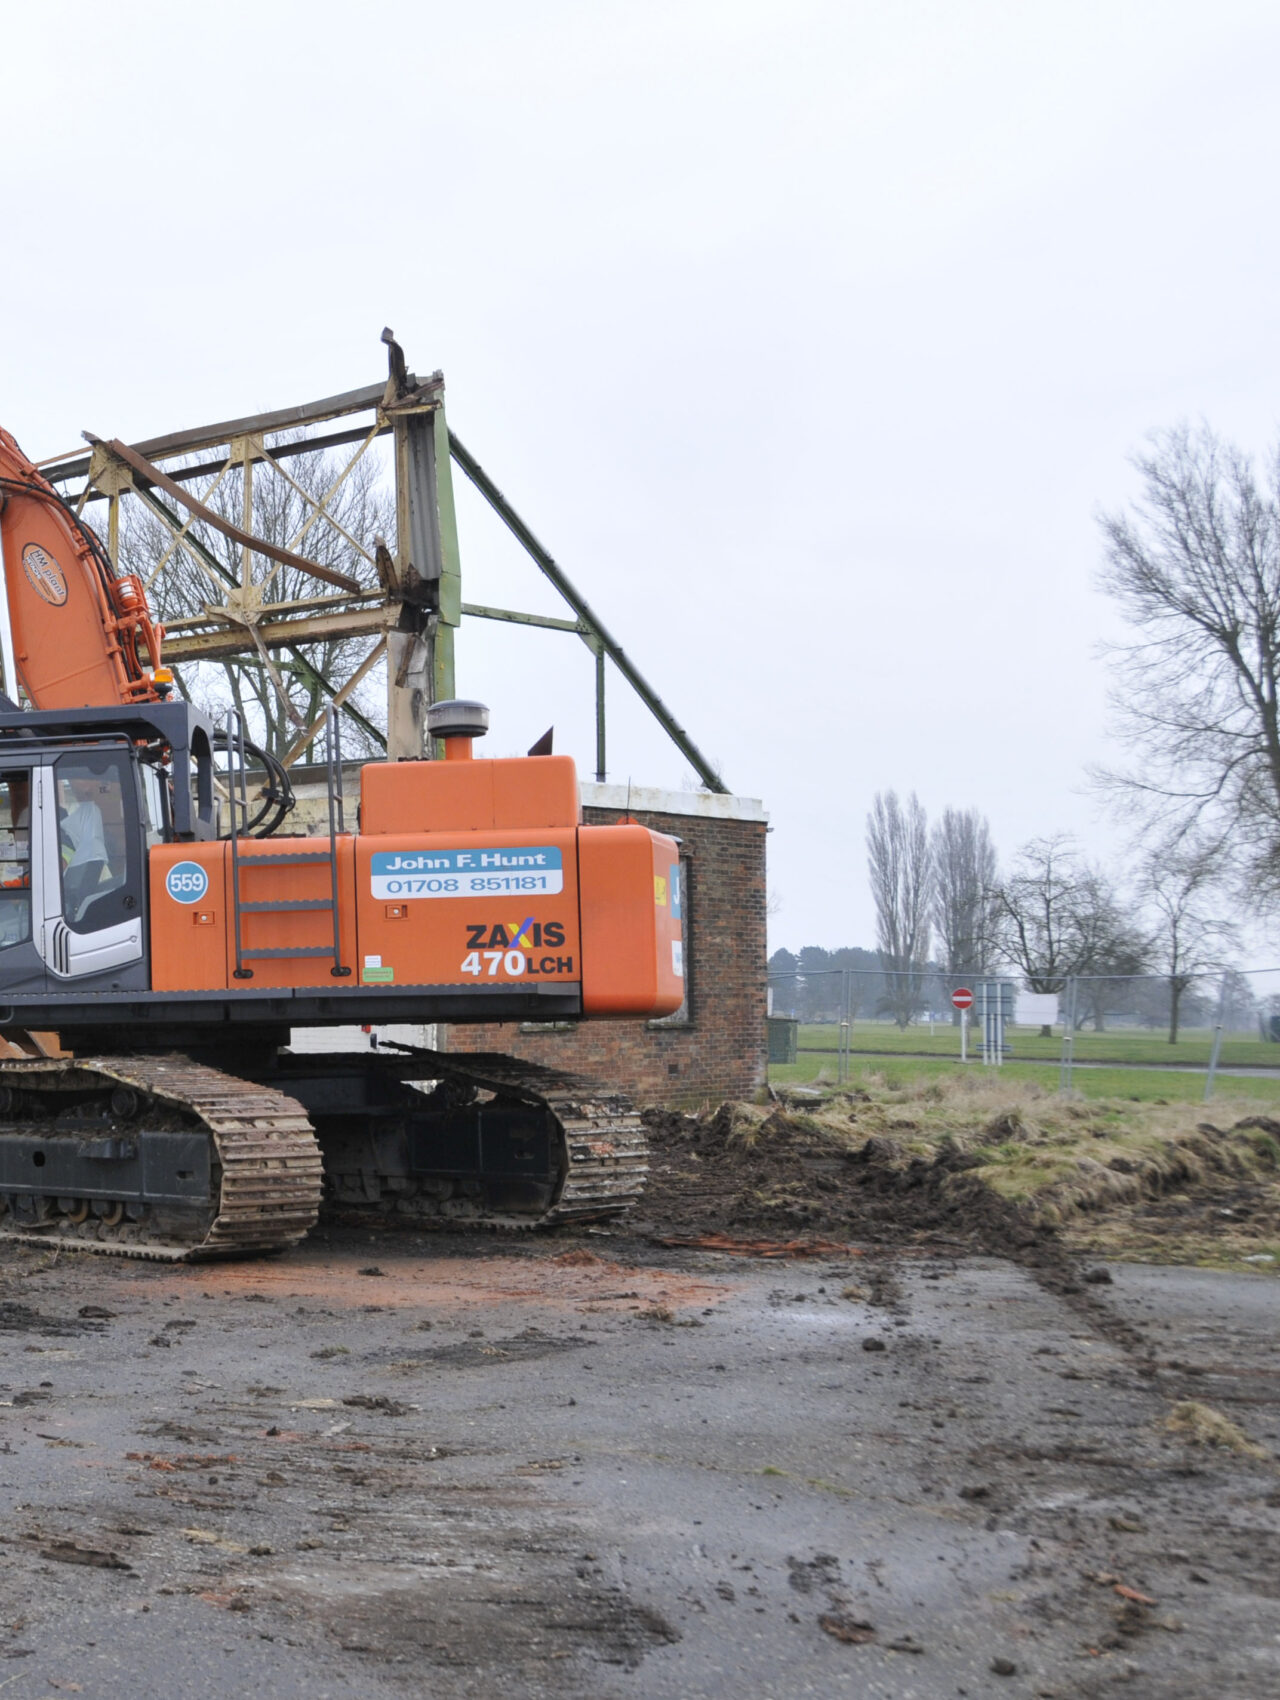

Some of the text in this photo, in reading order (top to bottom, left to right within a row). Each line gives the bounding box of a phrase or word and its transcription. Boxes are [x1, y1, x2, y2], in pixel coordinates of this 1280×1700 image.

[386, 852, 547, 871] John F. Hunt
[170, 872, 205, 893] 559
[386, 876, 548, 894] 01708 851181
[465, 916, 566, 950] ZAXIS
